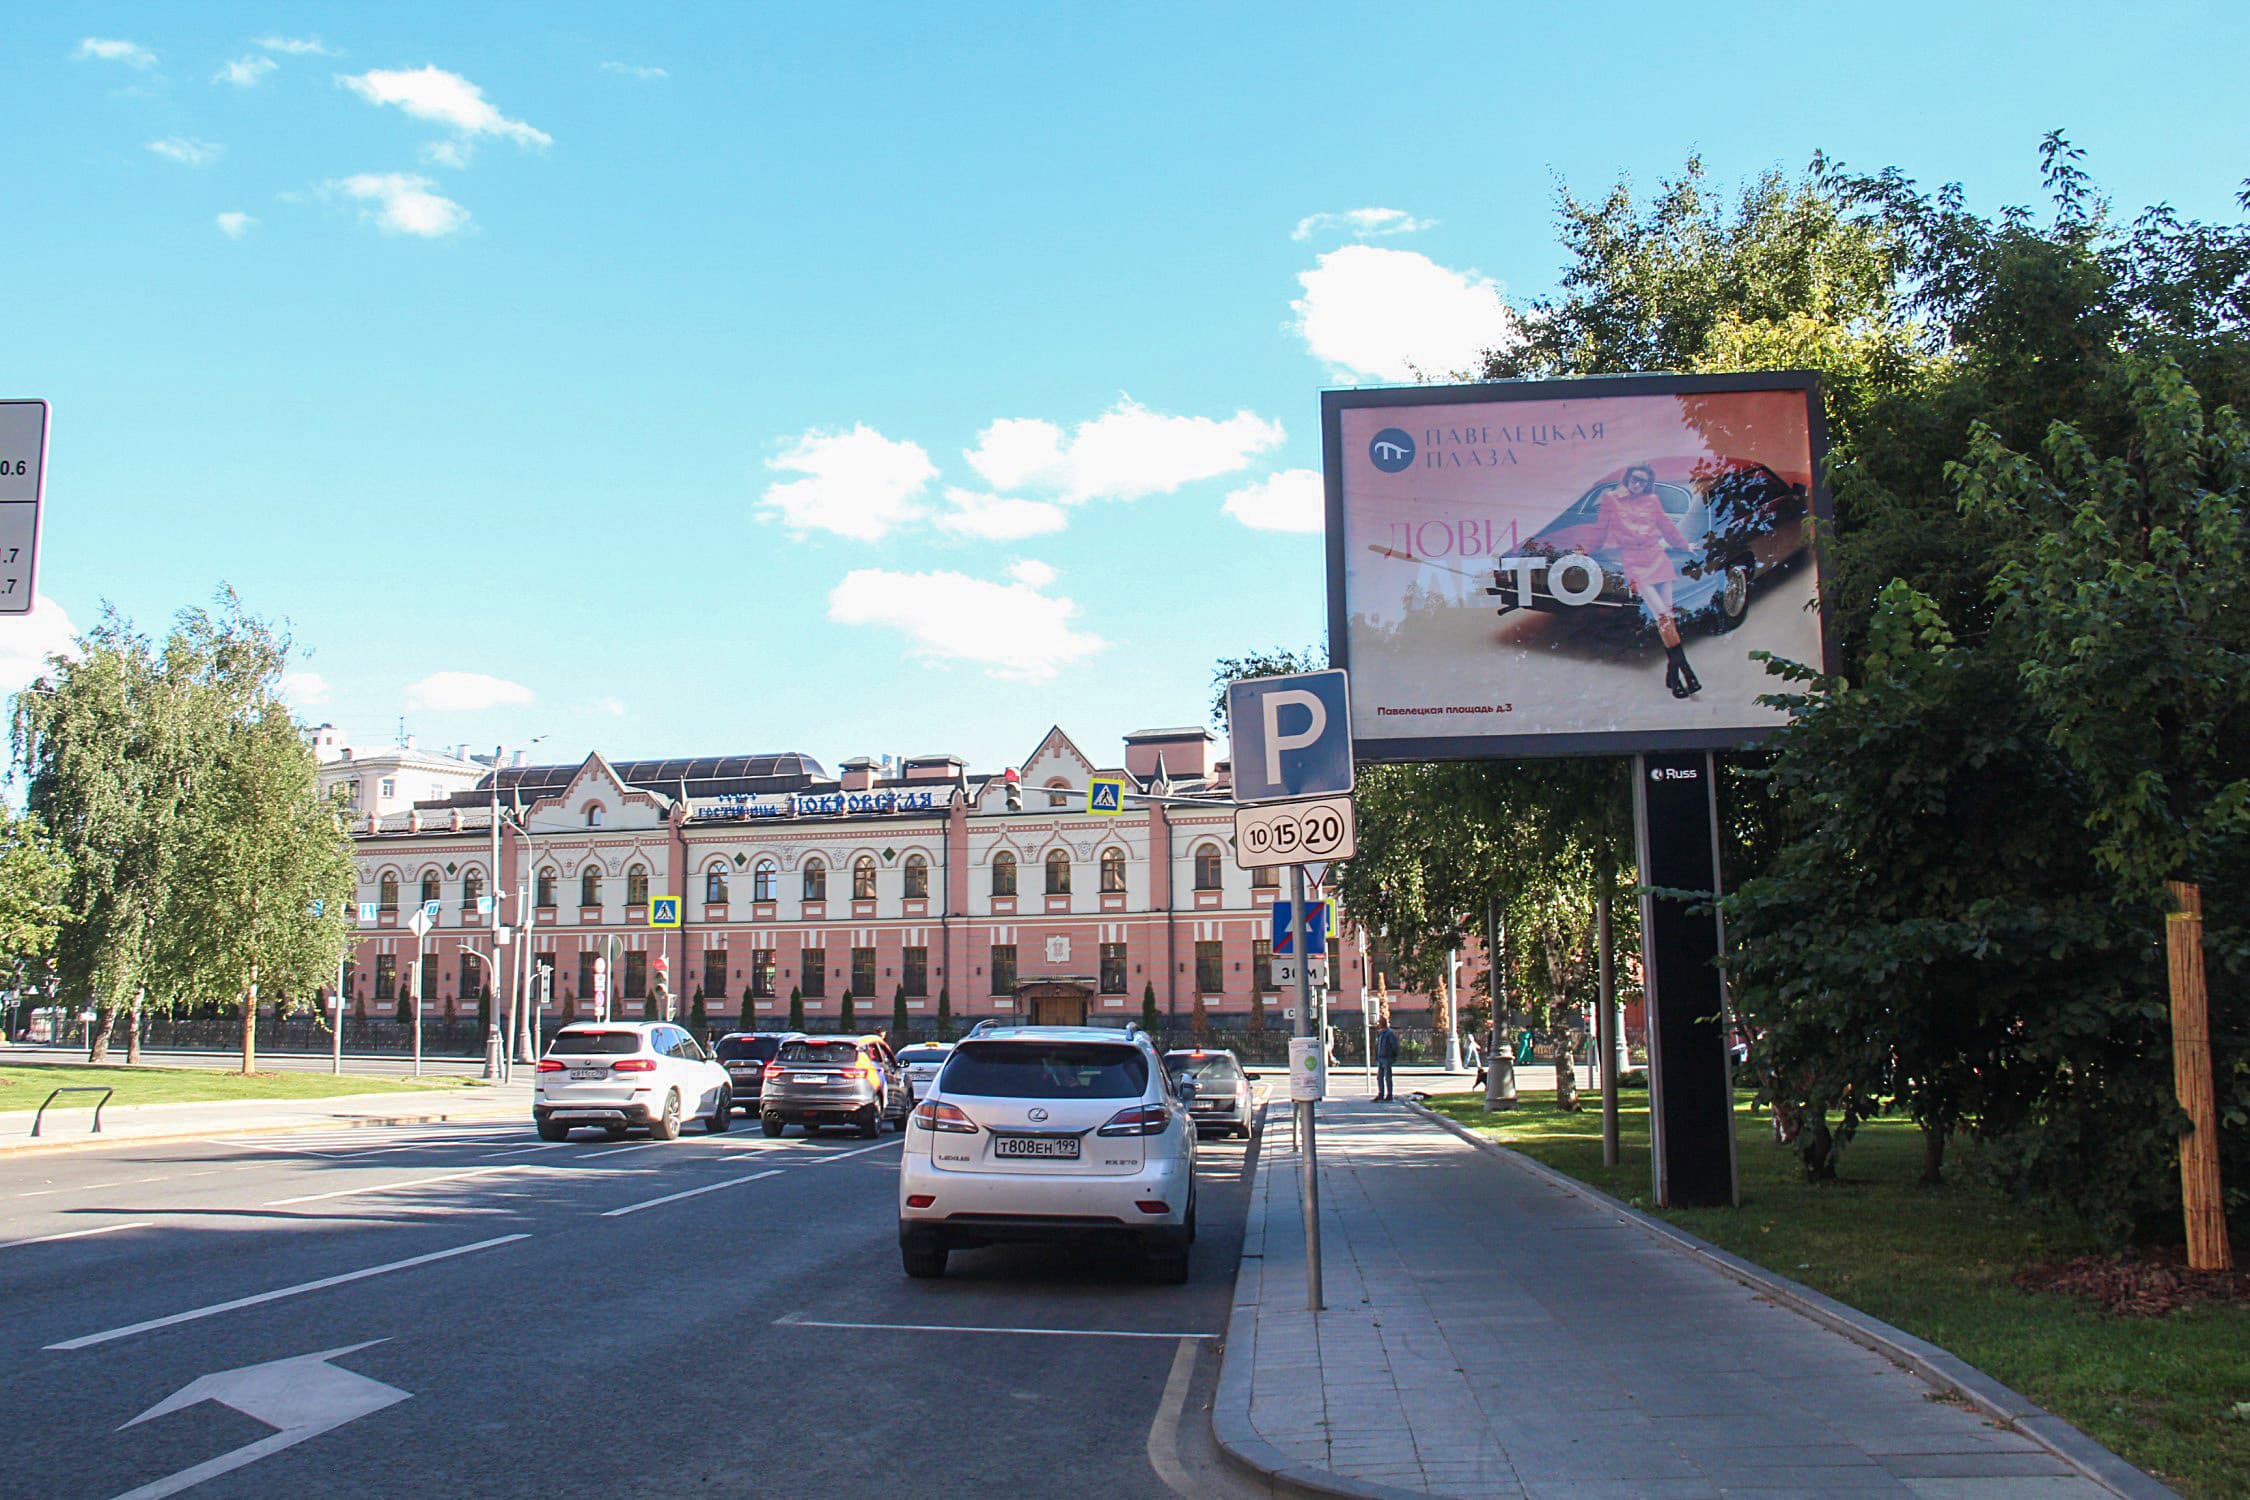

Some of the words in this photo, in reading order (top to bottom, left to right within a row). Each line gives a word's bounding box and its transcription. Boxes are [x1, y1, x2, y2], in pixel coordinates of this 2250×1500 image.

[1425, 421, 1605, 447] ПАВЕЛЕЦКАЯ
[1425, 447, 1518, 469] ПЛАЗА
[1384, 518, 1519, 559] ЛОВИ
[1377, 706, 1443, 715] Павелецкая
[1446, 704, 1493, 714] площадь
[1262, 689, 1327, 785] P
[1666, 768, 1697, 779] Russ
[1250, 829, 1267, 846] 10
[1275, 824, 1295, 845] 15
[1305, 816, 1339, 844] 20
[1001, 1139, 1053, 1154] Т808ЕН
[1056, 1139, 1075, 1151] 199
